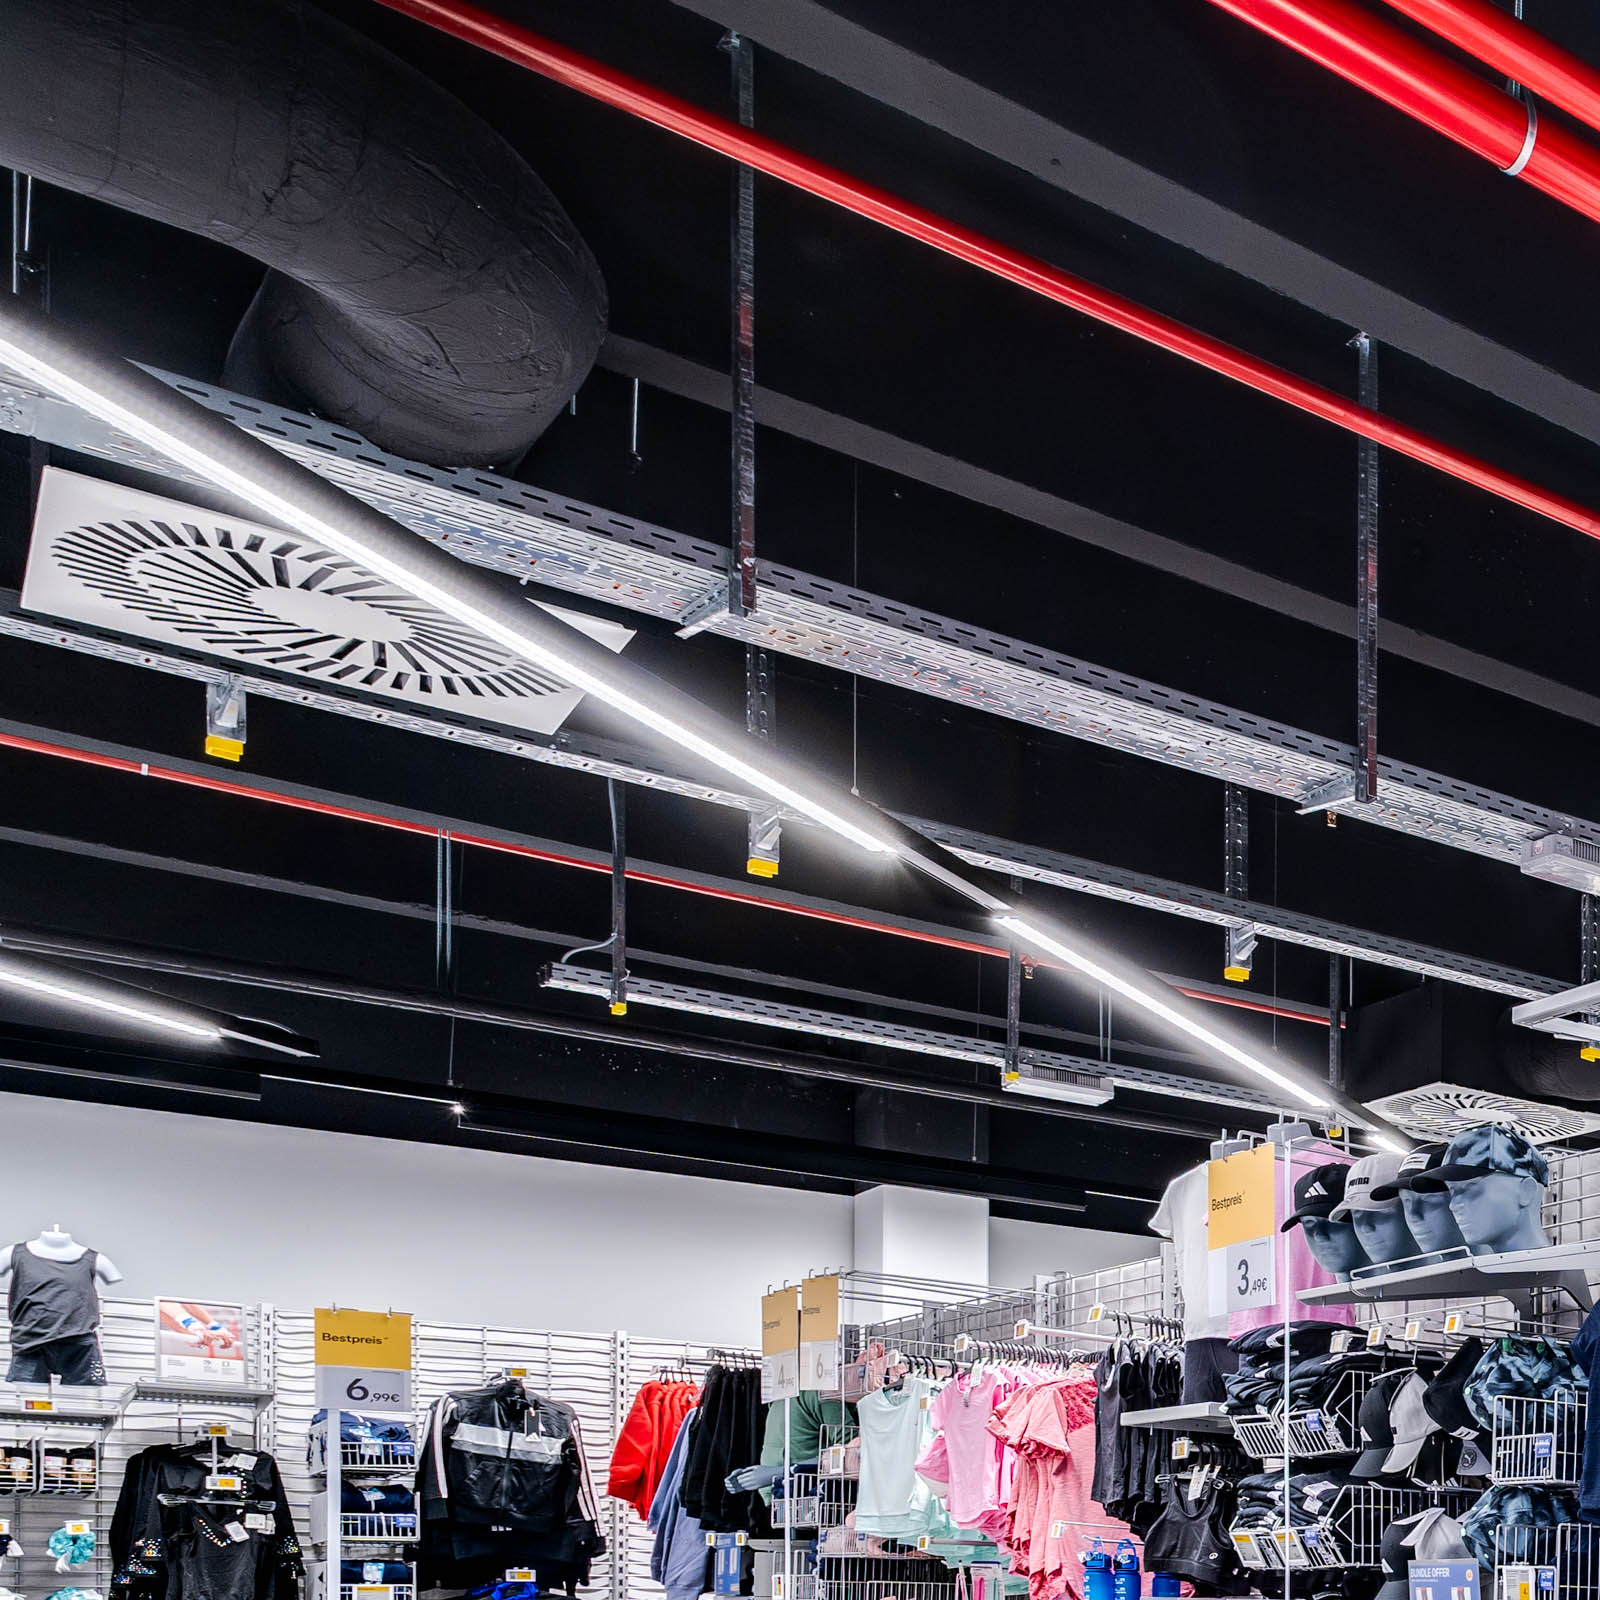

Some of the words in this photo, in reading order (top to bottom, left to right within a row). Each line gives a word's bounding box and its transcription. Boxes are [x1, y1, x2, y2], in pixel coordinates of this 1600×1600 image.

[1211, 1192, 1243, 1211] Bestpreis
[1237, 1258, 1267, 1296] 3,49€
[322, 1332, 383, 1345] Bestpreis
[346, 1378, 400, 1403] 6,99€
[1409, 1568, 1431, 1578] BUNDLE
[1432, 1567, 1450, 1577] OFFER
